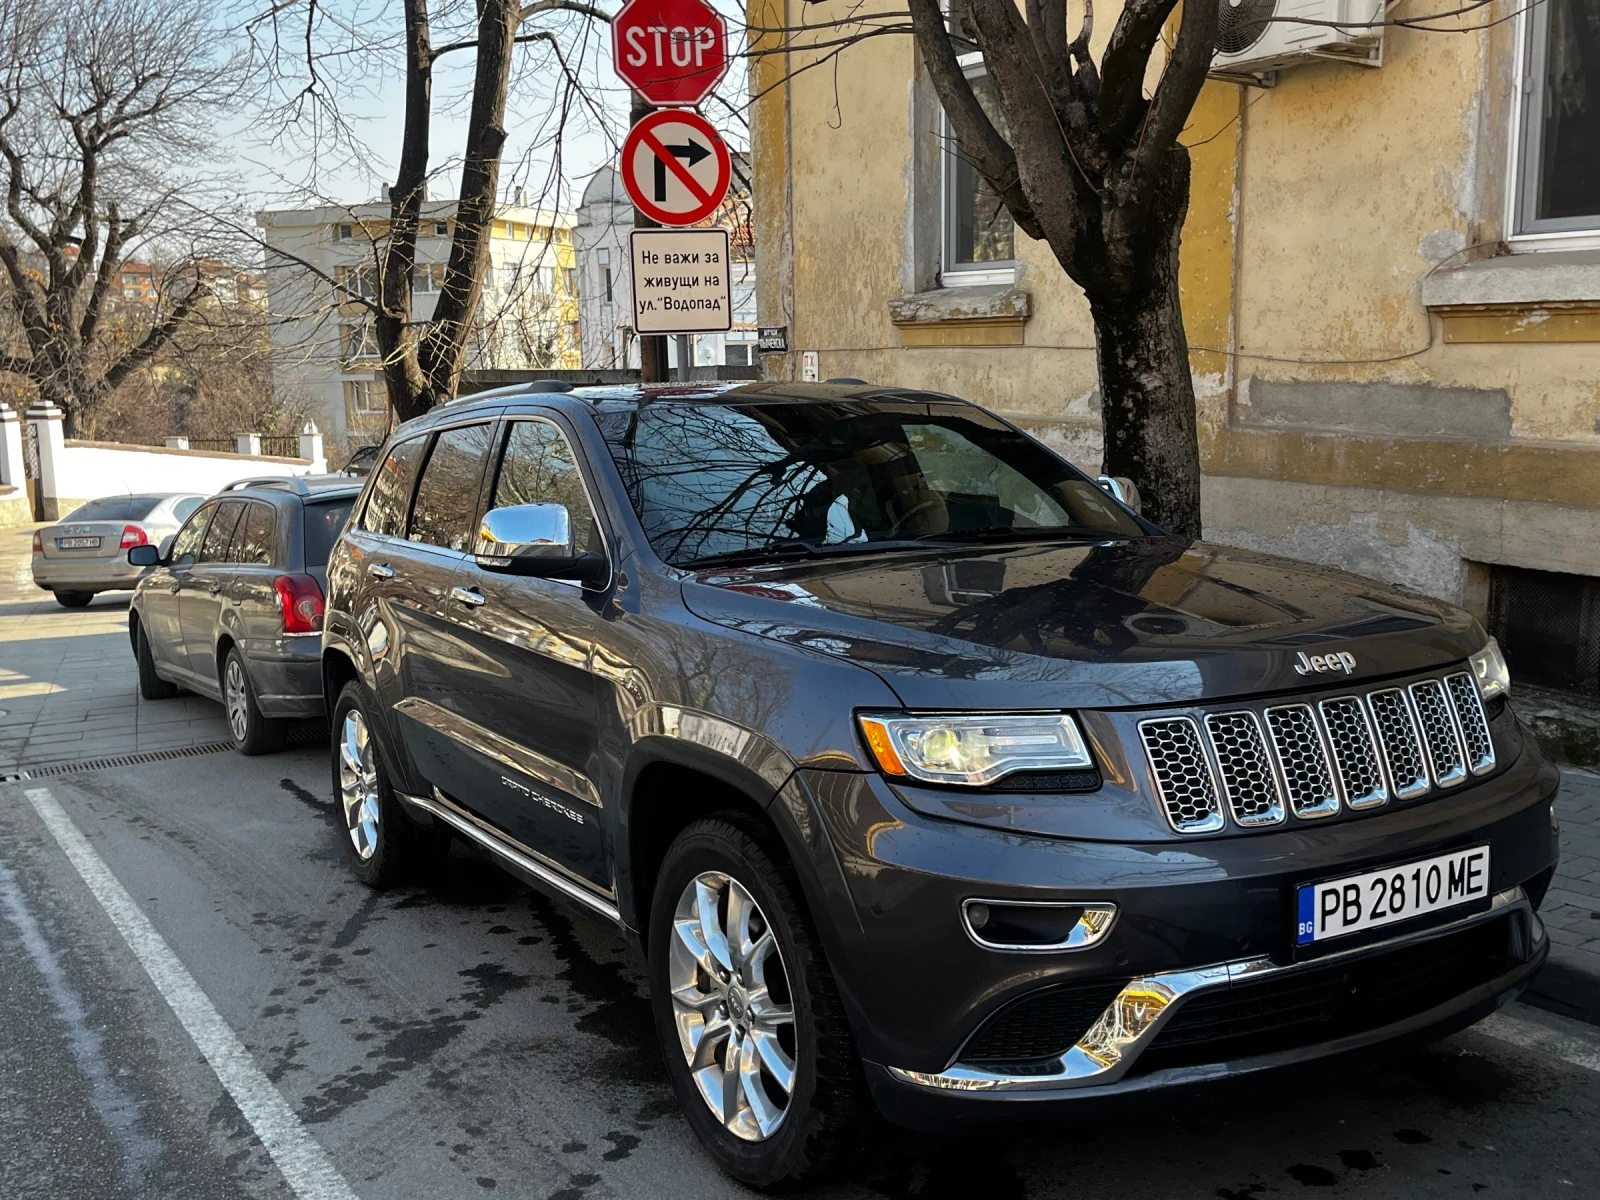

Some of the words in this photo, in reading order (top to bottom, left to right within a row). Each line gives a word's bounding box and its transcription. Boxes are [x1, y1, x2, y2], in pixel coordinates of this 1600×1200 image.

[625, 25, 715, 67] STOP
[641, 250, 659, 264] Не
[664, 253, 699, 264] важи
[704, 252, 720, 263] за
[643, 276, 699, 290] живущи
[704, 275, 720, 286] на
[1293, 651, 1357, 676] Jeep
[531, 791, 584, 825] CHEROKEE
[1320, 883, 1362, 932] PB
[1369, 864, 1441, 920] 2810
[1447, 852, 1484, 900] ME
[1298, 921, 1313, 936] BG
